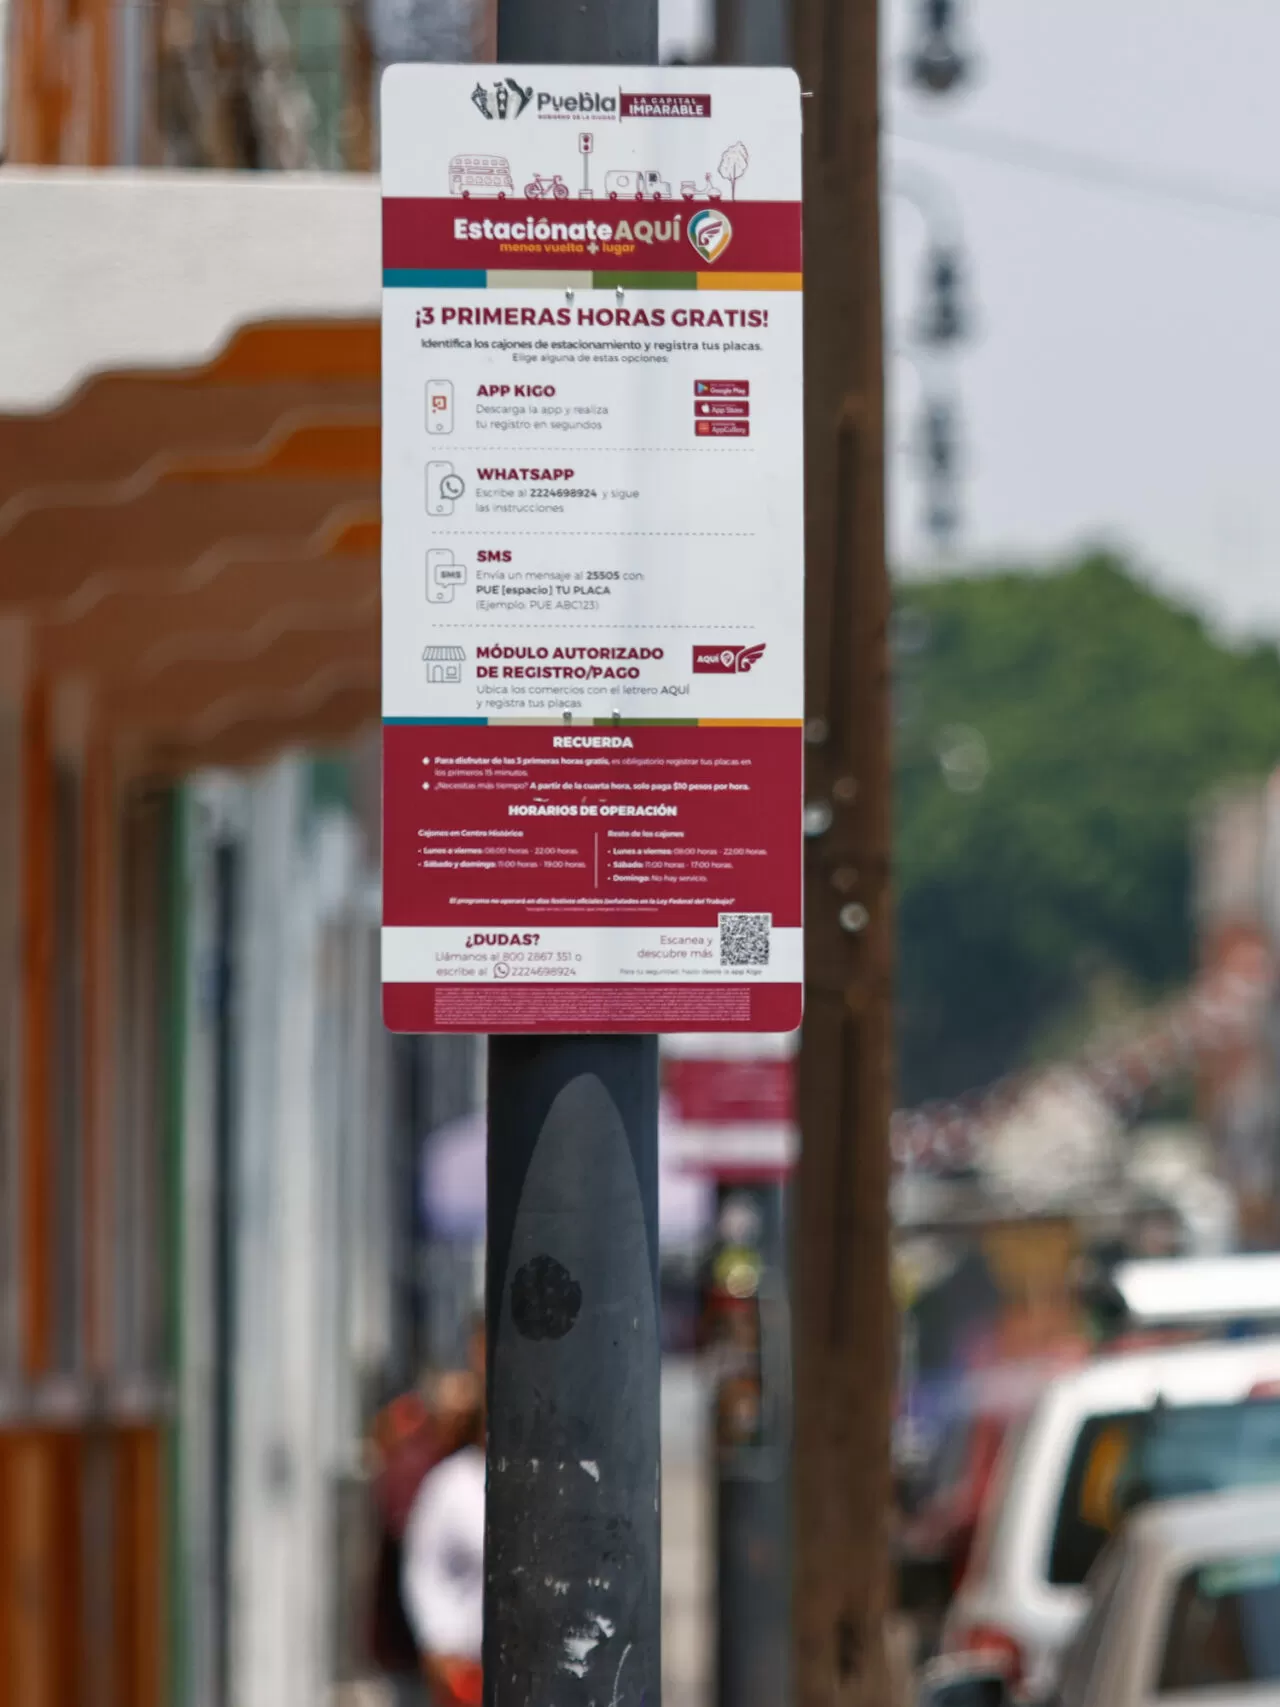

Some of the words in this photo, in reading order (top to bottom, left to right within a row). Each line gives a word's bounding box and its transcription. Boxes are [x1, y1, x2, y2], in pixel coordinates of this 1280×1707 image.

[537, 92, 616, 112] Puebla
[633, 96, 647, 105] LA
[651, 97, 696, 105] CAPITAL
[628, 104, 705, 116] IMPARABLE
[499, 243, 542, 253] menos
[543, 242, 584, 253] vuelta
[602, 243, 635, 254] lugar
[415, 306, 435, 329] ¡3
[441, 307, 571, 326] PRIMERAS
[577, 308, 666, 327] HORAS
[671, 308, 768, 328] GRATIS!
[421, 338, 472, 349] Identifica
[474, 338, 490, 349] los
[490, 339, 533, 351] cajones
[534, 339, 549, 349] de
[550, 339, 642, 350] estacionamiento
[653, 340, 699, 353] registra
[701, 341, 720, 351] tus
[722, 341, 762, 353] placas.
[512, 352, 538, 364] Elige
[540, 354, 576, 364] alguna
[577, 353, 591, 363] de
[592, 354, 620, 363] estas
[476, 384, 511, 397] APP
[514, 384, 556, 398] KIGO
[475, 403, 526, 417] Descarga
[528, 405, 539, 414] la
[541, 406, 563, 416] app
[573, 405, 609, 415] realiza
[475, 420, 488, 429] tu
[490, 419, 532, 432] registro
[533, 421, 547, 430] en
[549, 420, 603, 432] segundos
[476, 468, 575, 481] WHATSAPP
[476, 488, 515, 498] Escribe
[529, 488, 598, 498] 2224698924
[611, 490, 640, 500] sigue
[475, 503, 491, 513] las
[492, 504, 565, 513] instrucciones
[476, 550, 512, 563] SMS
[440, 570, 462, 579] SMS
[476, 570, 505, 580] Envía
[508, 572, 523, 580] un
[525, 572, 571, 582] mensaje
[586, 570, 621, 581] 25505
[476, 584, 500, 595] PUE
[501, 585, 553, 596] [espacio]
[555, 585, 571, 595] TU
[573, 585, 611, 595] PLACA
[528, 600, 552, 610] PUE
[554, 600, 599, 611] ABC123)
[476, 643, 549, 659] MÓDULO
[552, 647, 664, 660] AUTORIZADO
[696, 654, 720, 665] AQUÍ
[476, 665, 499, 679] DE
[502, 665, 640, 680] REGISTRO/PAGO
[476, 684, 509, 695] Ubica
[511, 685, 526, 694] los
[528, 686, 585, 695] comercios
[587, 687, 608, 695] con
[609, 685, 621, 695] el
[622, 684, 659, 696] letrero
[659, 683, 690, 697] AQUÍ
[485, 699, 526, 710] registra
[528, 699, 545, 708] tus
[547, 698, 582, 712] placas
[552, 736, 634, 748] RECUERDA
[434, 756, 454, 765] Para
[455, 756, 490, 765] disfrutar
[491, 756, 503, 765] de
[503, 756, 516, 765] las
[523, 756, 559, 765] primeras
[561, 756, 584, 765] horas
[585, 757, 611, 766] gratis,
[621, 757, 665, 766] obligatorio
[666, 757, 699, 766] registrar
[700, 757, 713, 766] tus
[713, 757, 740, 766] placas
[740, 757, 752, 766] en
[434, 769, 447, 777] los
[447, 769, 484, 777] primeros
[493, 769, 528, 777] minutos.
[508, 805, 578, 816] HORARIOS
[579, 805, 598, 816] DE
[599, 802, 678, 817] OPERACIÓN
[418, 829, 449, 838] Cajones
[449, 829, 460, 838] en
[461, 829, 487, 838] Centro
[488, 829, 524, 838] Histórico
[607, 829, 630, 839] Resto
[630, 829, 641, 839] de
[642, 829, 653, 839] los
[654, 829, 685, 839] cajones
[465, 933, 540, 949] ¿DUDAS?
[660, 935, 705, 945] Escanea
[435, 952, 487, 962] Llámanos
[502, 952, 525, 962] 800
[527, 952, 553, 962] 2867
[556, 952, 572, 962] 351
[637, 948, 688, 961] descubre
[690, 948, 713, 958] más
[435, 967, 476, 977] escribe
[478, 967, 489, 977] al
[511, 966, 577, 977] 2224698924
